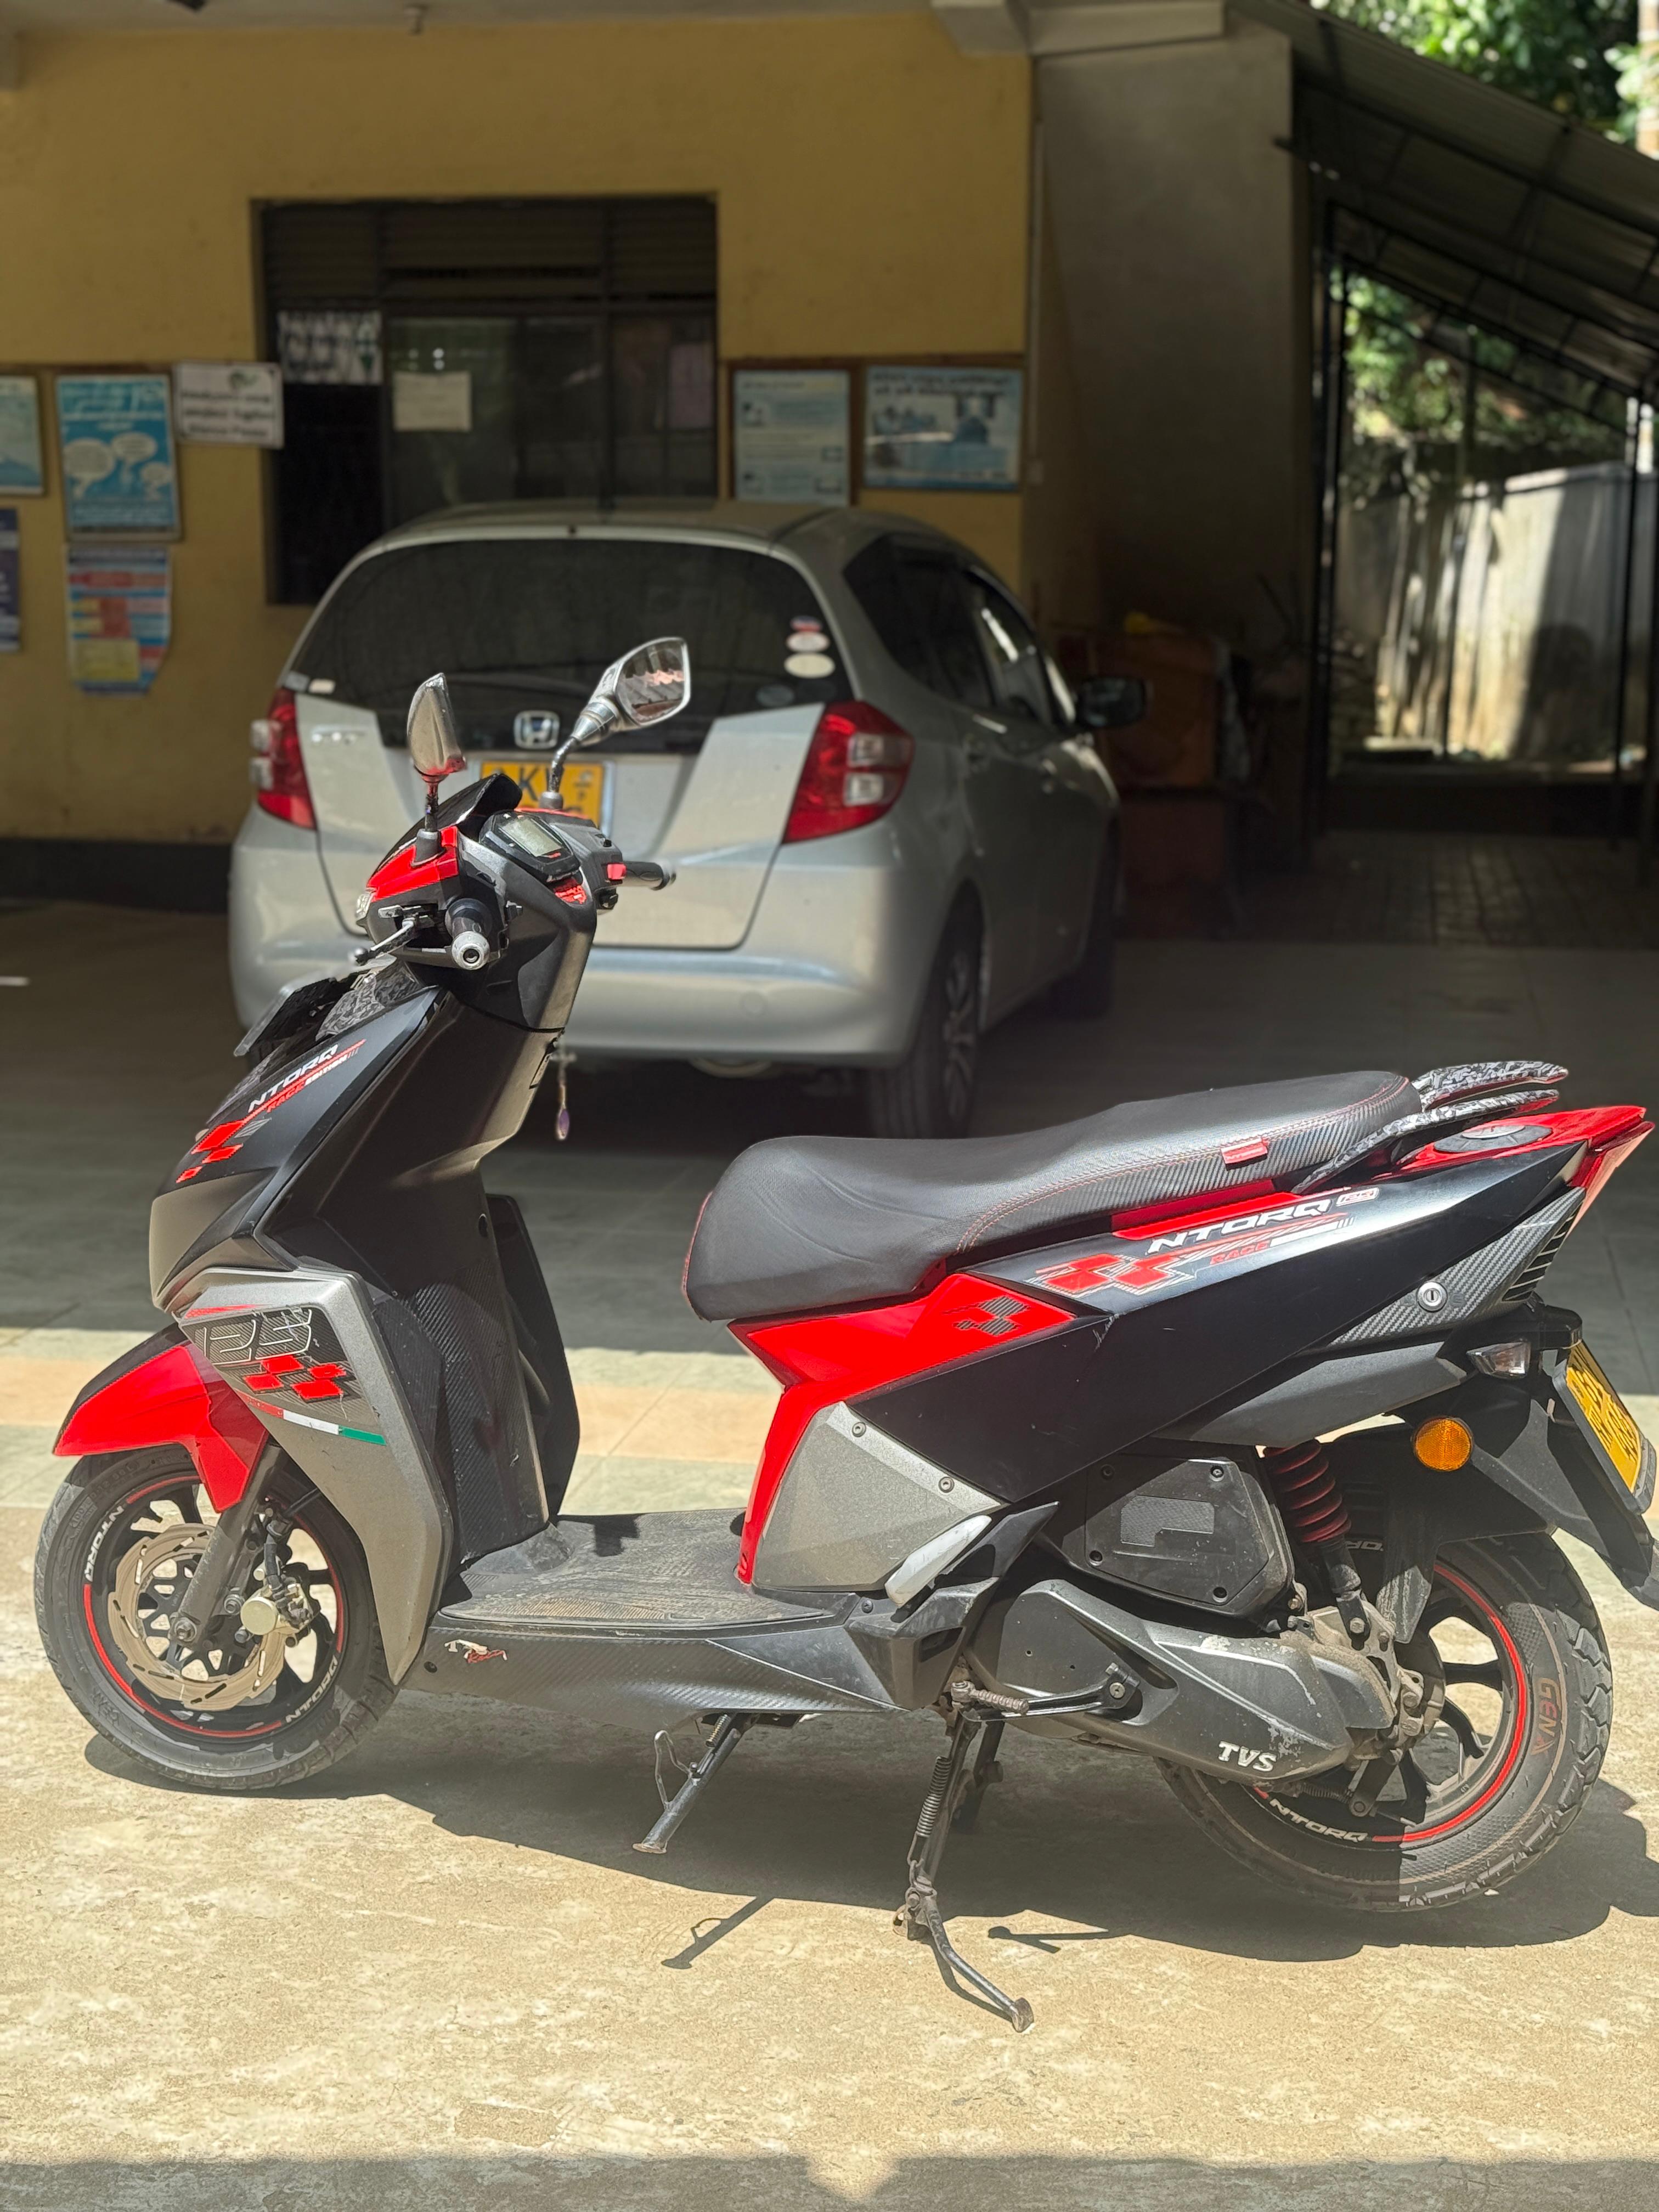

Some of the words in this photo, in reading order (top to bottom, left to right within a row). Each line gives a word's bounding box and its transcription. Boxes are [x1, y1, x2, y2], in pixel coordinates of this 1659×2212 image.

[248, 1043, 339, 1113] NTORQ
[1147, 1198, 1332, 1255] NTORQ
[1209, 1239, 1270, 1265] RACE
[84, 1505, 125, 1582] NTORQ
[285, 1654, 338, 1723] NTORQ
[1218, 1740, 1277, 1771] TVS
[1269, 1798, 1368, 1843] NTORQ
